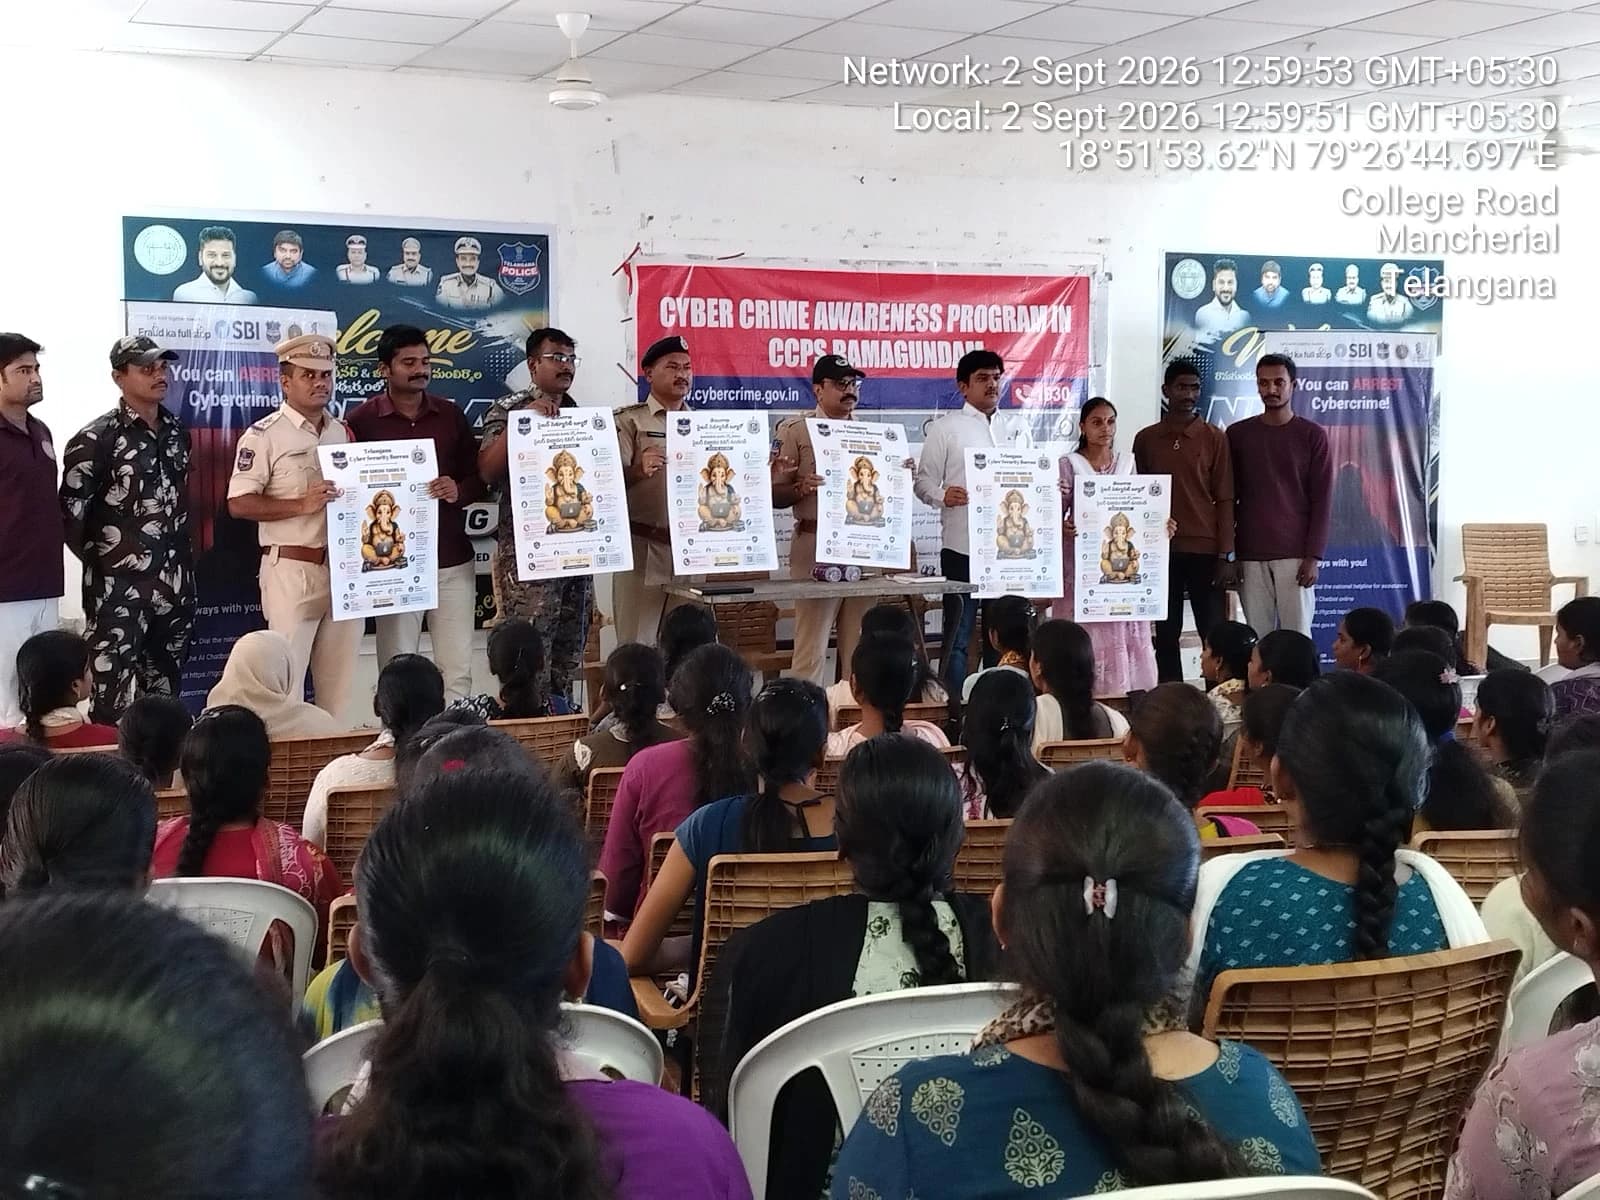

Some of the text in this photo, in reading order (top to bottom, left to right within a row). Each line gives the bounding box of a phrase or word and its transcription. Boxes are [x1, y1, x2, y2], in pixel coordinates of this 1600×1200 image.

[502, 266, 538, 277] POLICE
[659, 296, 1072, 334] CYBER CRIME AWARENESS PROGRAM IN
[178, 327, 192, 339] full
[232, 320, 260, 341] SBI
[768, 337, 828, 369] CCPS
[1349, 343, 1373, 359] SBI
[170, 364, 280, 383] You can ARRE
[1297, 376, 1405, 391] You can ARREST
[189, 388, 283, 413] Cybercrime!
[1311, 395, 1390, 413] Cybercrime!
[1331, 558, 1349, 567] with
[221, 603, 242, 614] with
